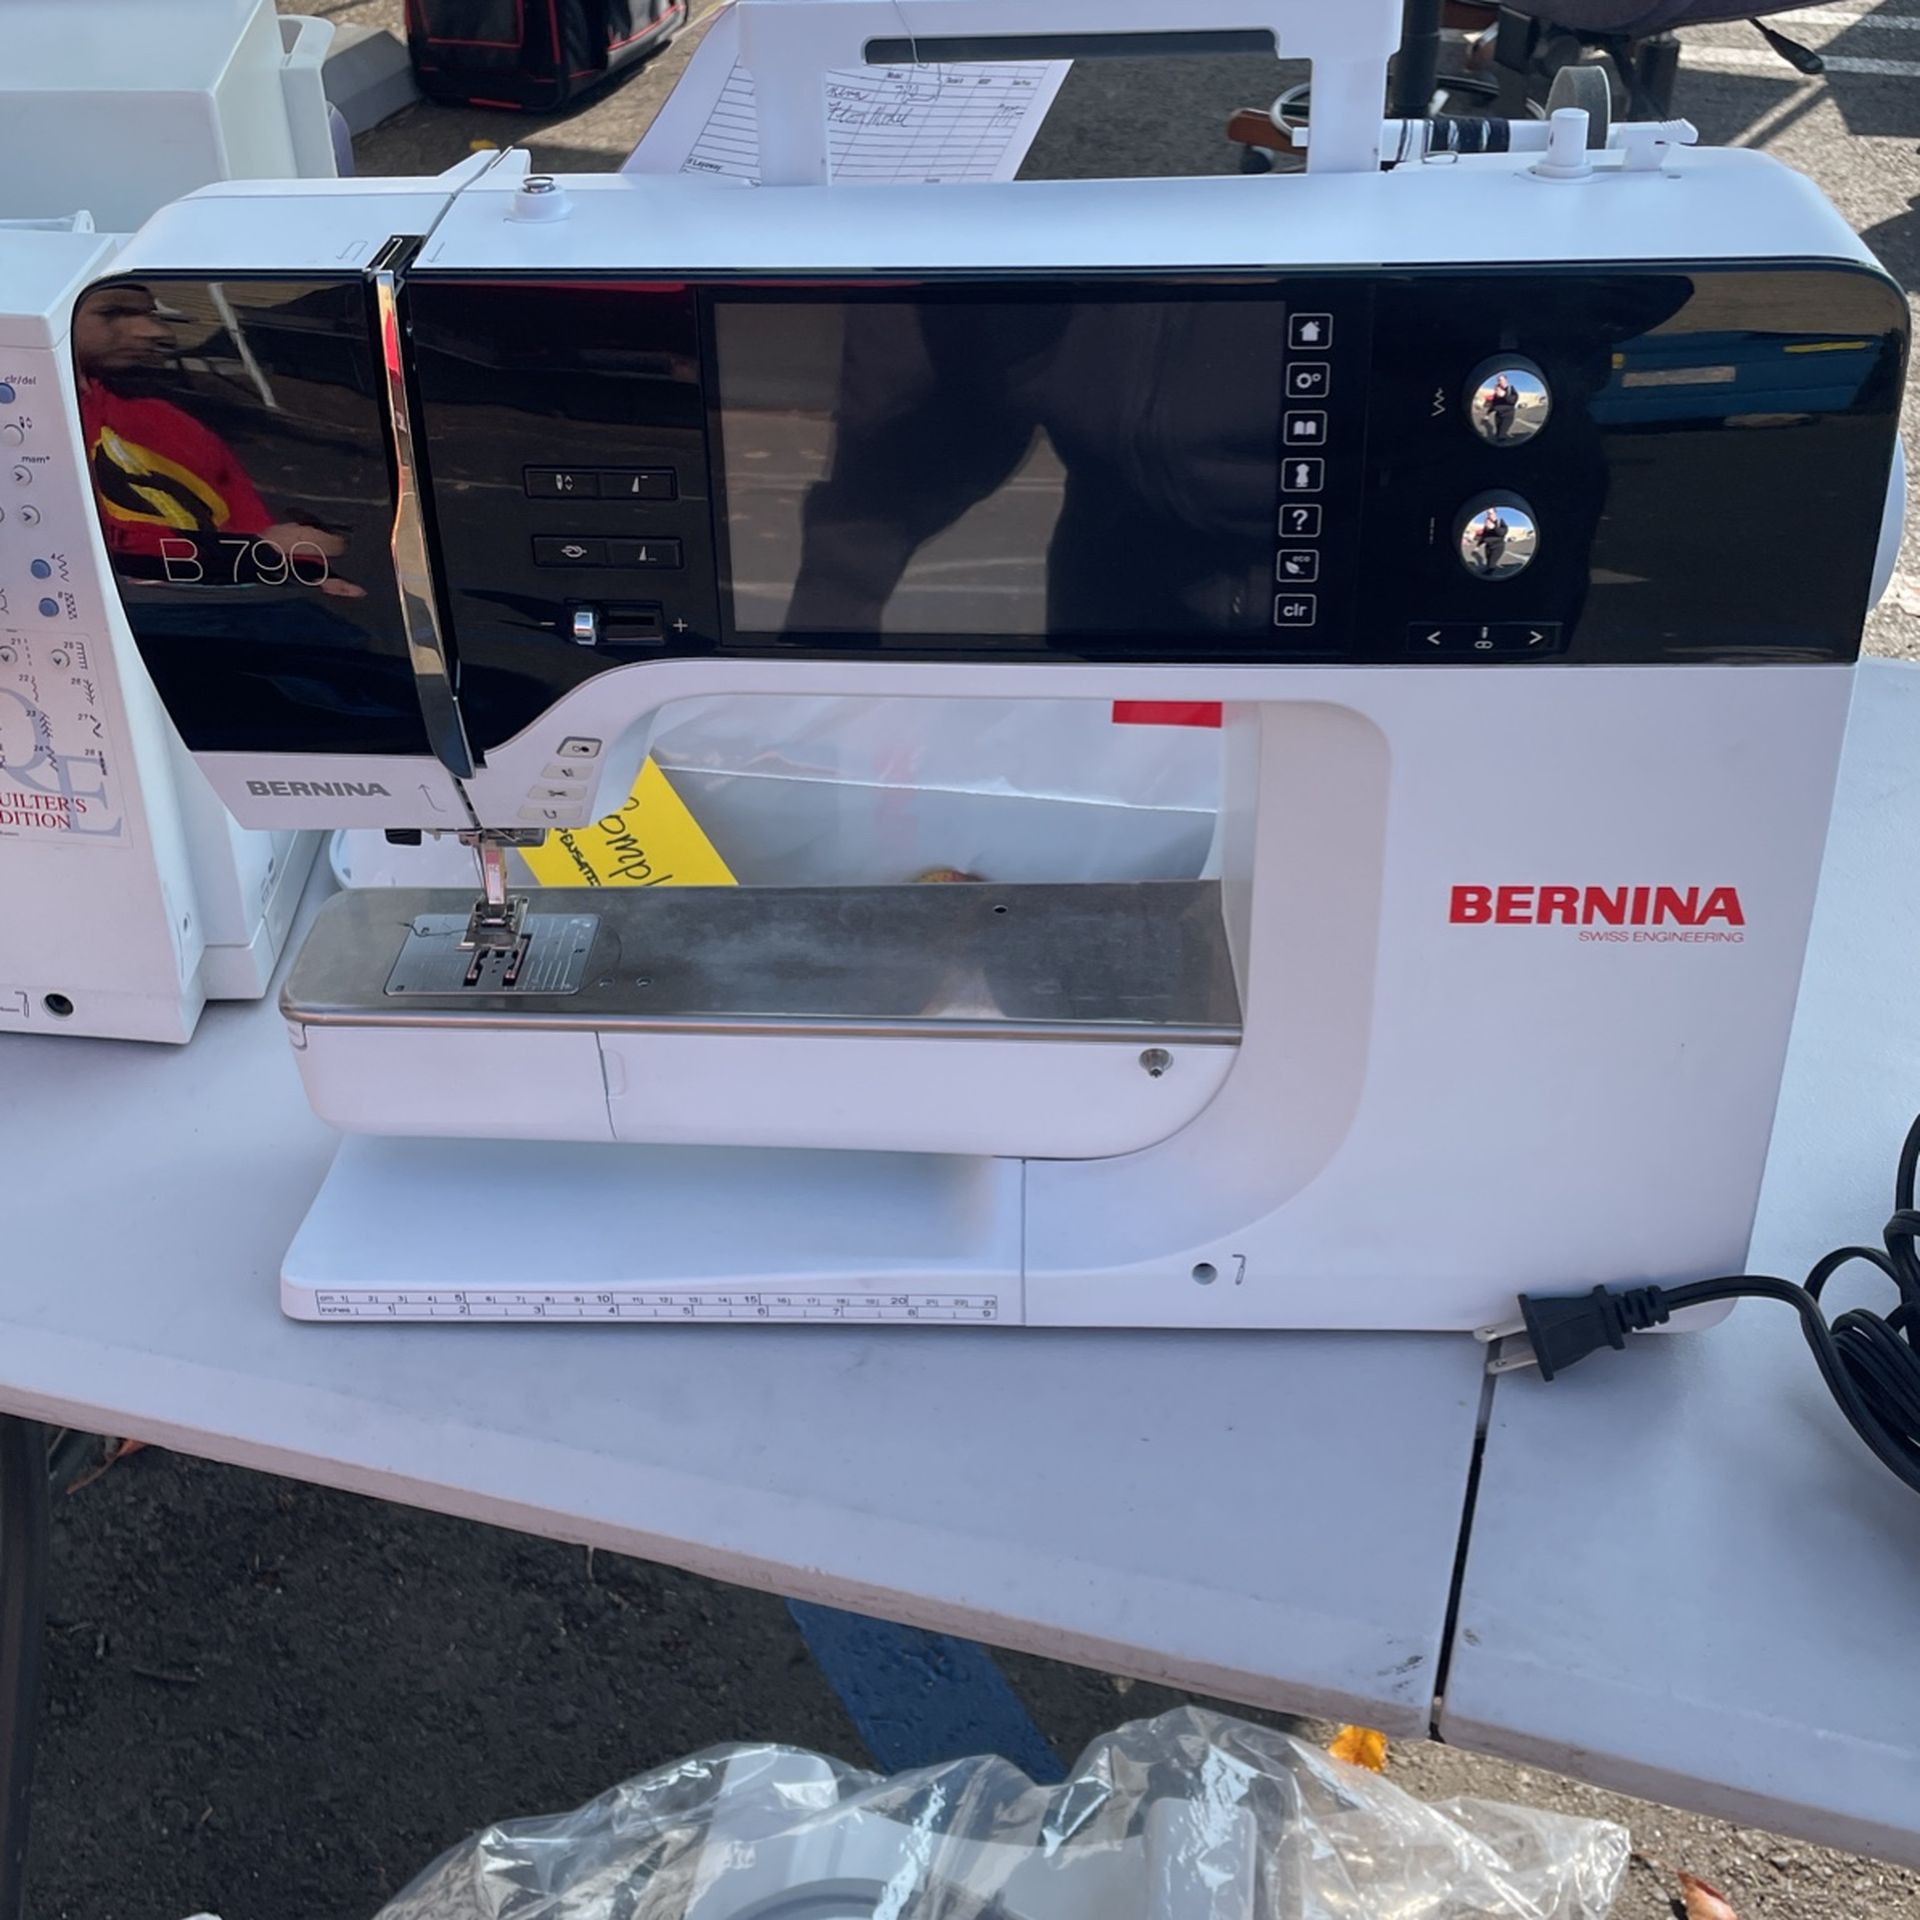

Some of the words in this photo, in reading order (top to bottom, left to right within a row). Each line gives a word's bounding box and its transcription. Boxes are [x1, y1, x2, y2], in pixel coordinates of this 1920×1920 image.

[160, 538, 203, 582] B
[219, 540, 328, 586] 790
[1283, 603, 1308, 617] clr
[246, 780, 391, 798] BERNINA
[1449, 885, 1746, 926] BERNINA
[1578, 930, 1630, 943] SWISS
[1632, 931, 1745, 944] ENGINEERING
